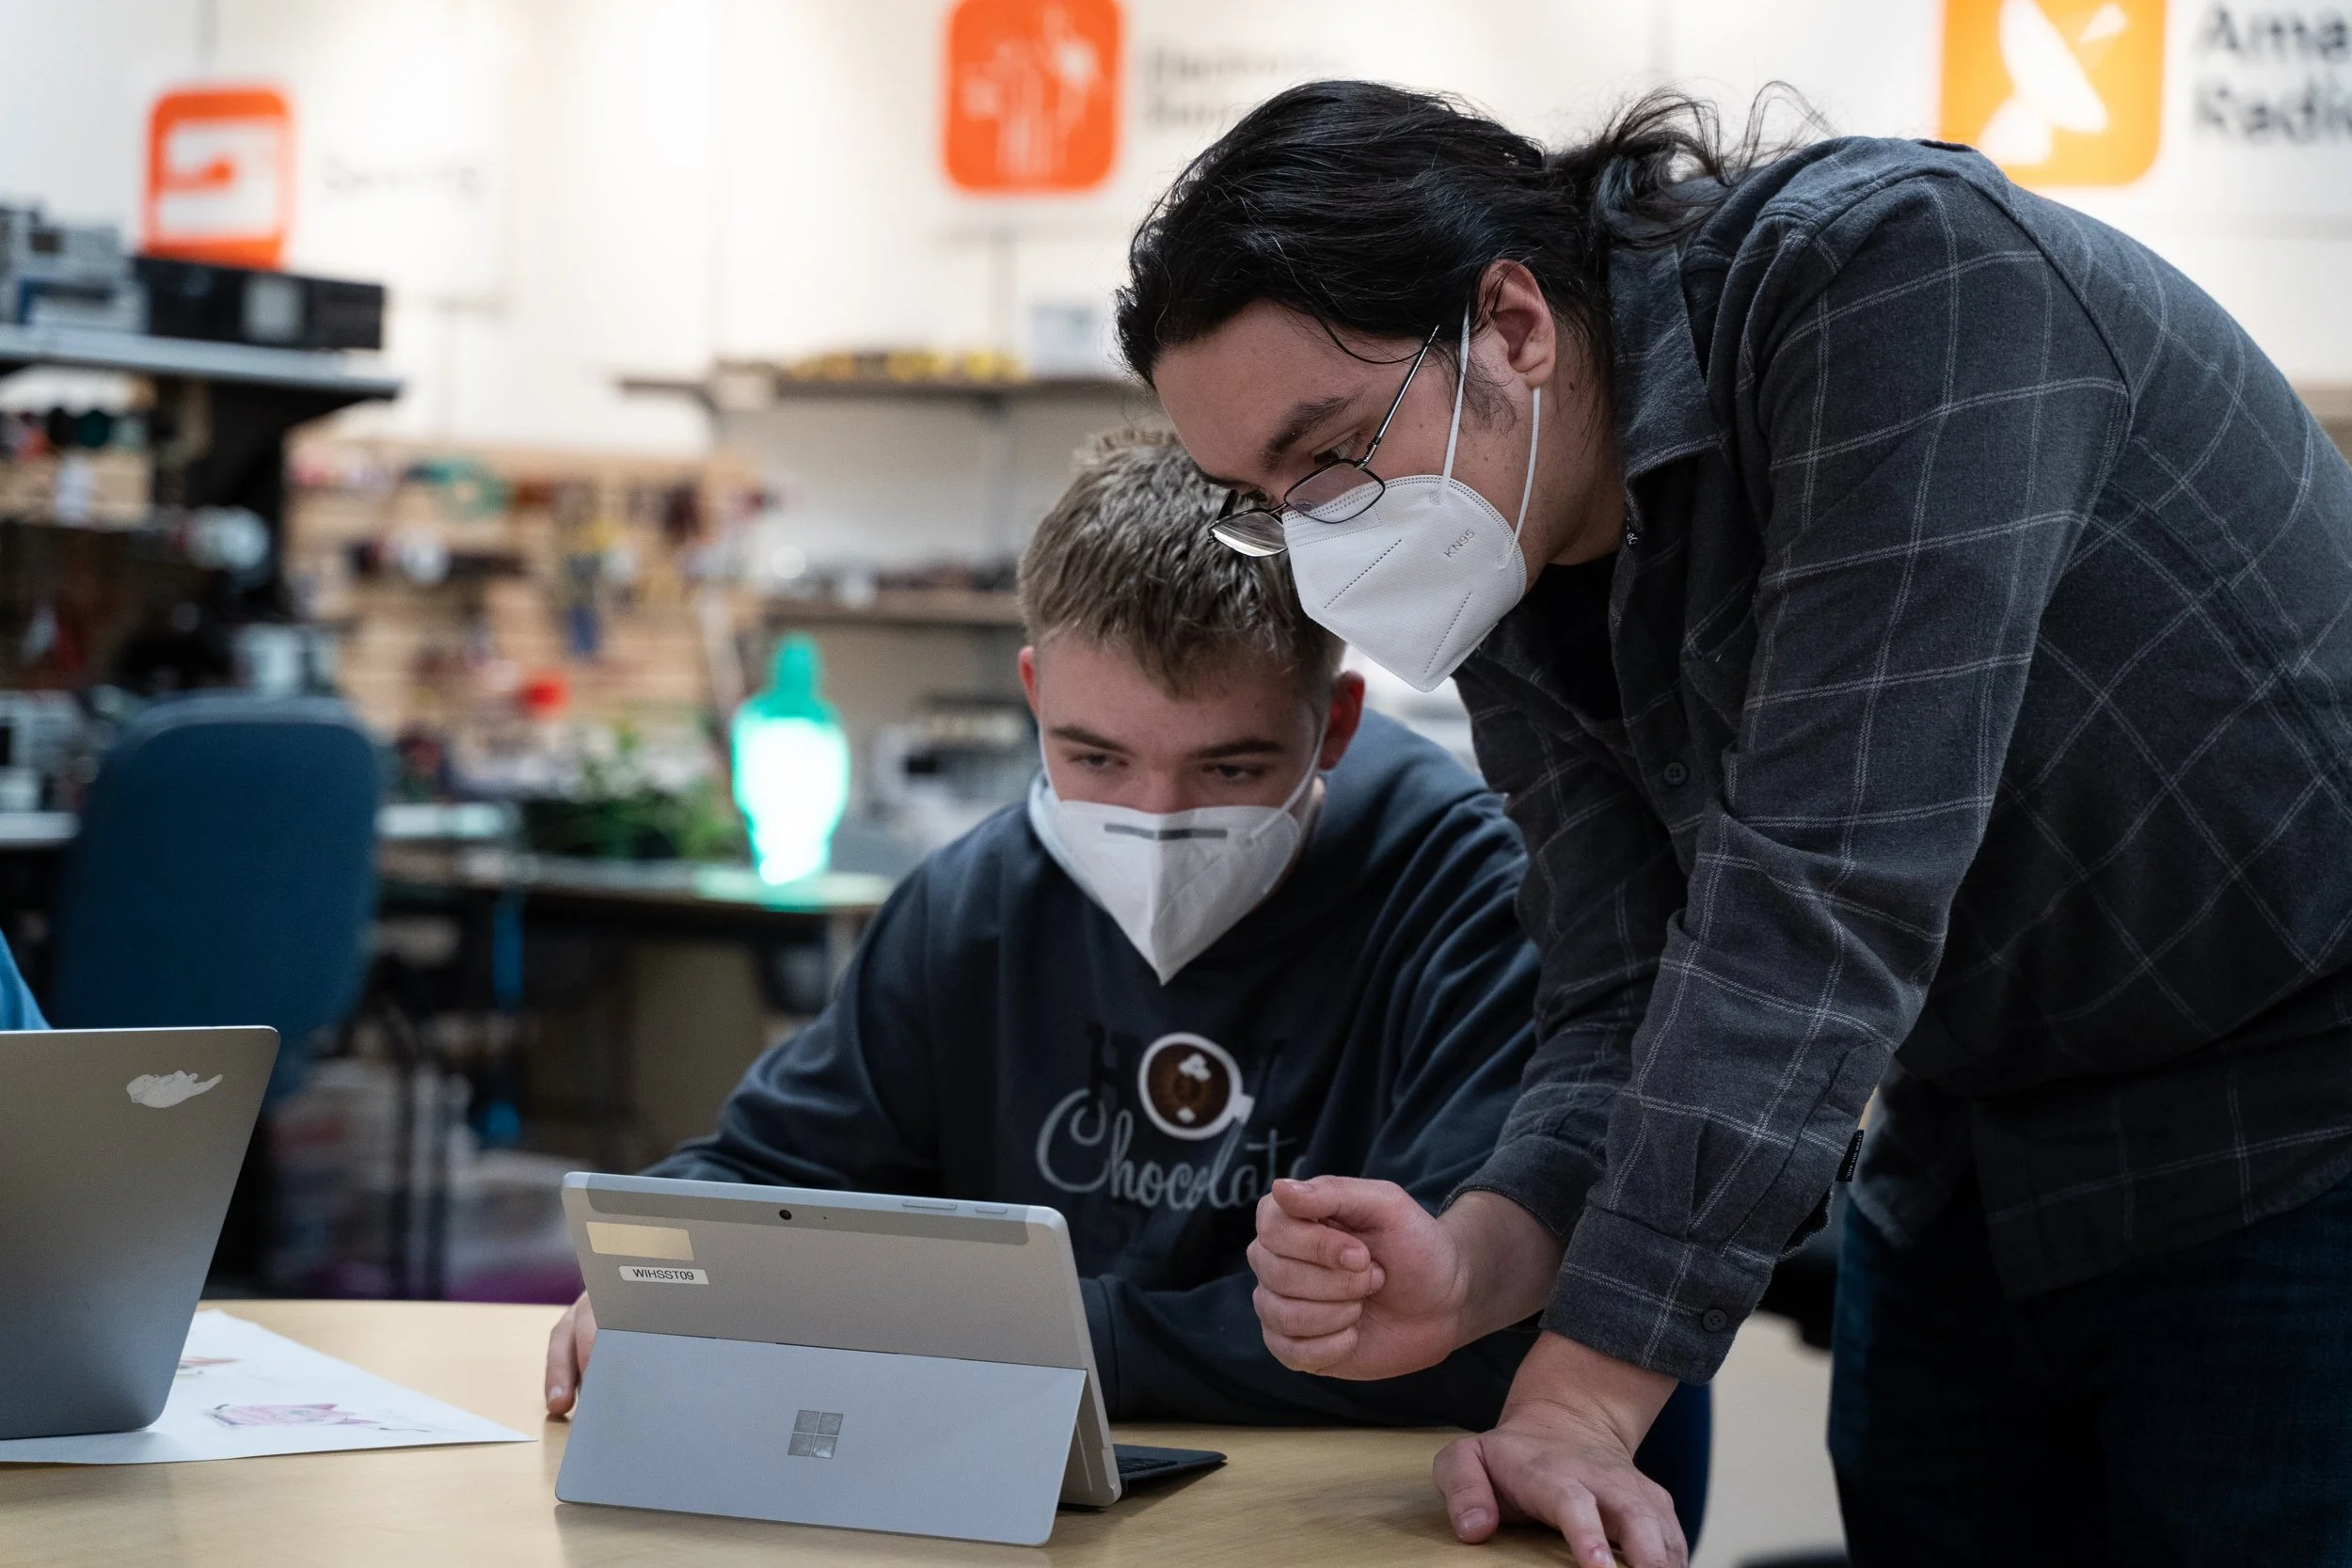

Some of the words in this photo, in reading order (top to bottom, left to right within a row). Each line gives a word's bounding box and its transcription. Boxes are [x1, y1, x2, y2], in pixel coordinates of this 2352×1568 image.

[2192, 77, 2352, 144] Radi
[1443, 530, 1475, 558] KN95
[1036, 1088, 1308, 1210] Chocolat
[632, 1268, 694, 1280] WIHSST09
